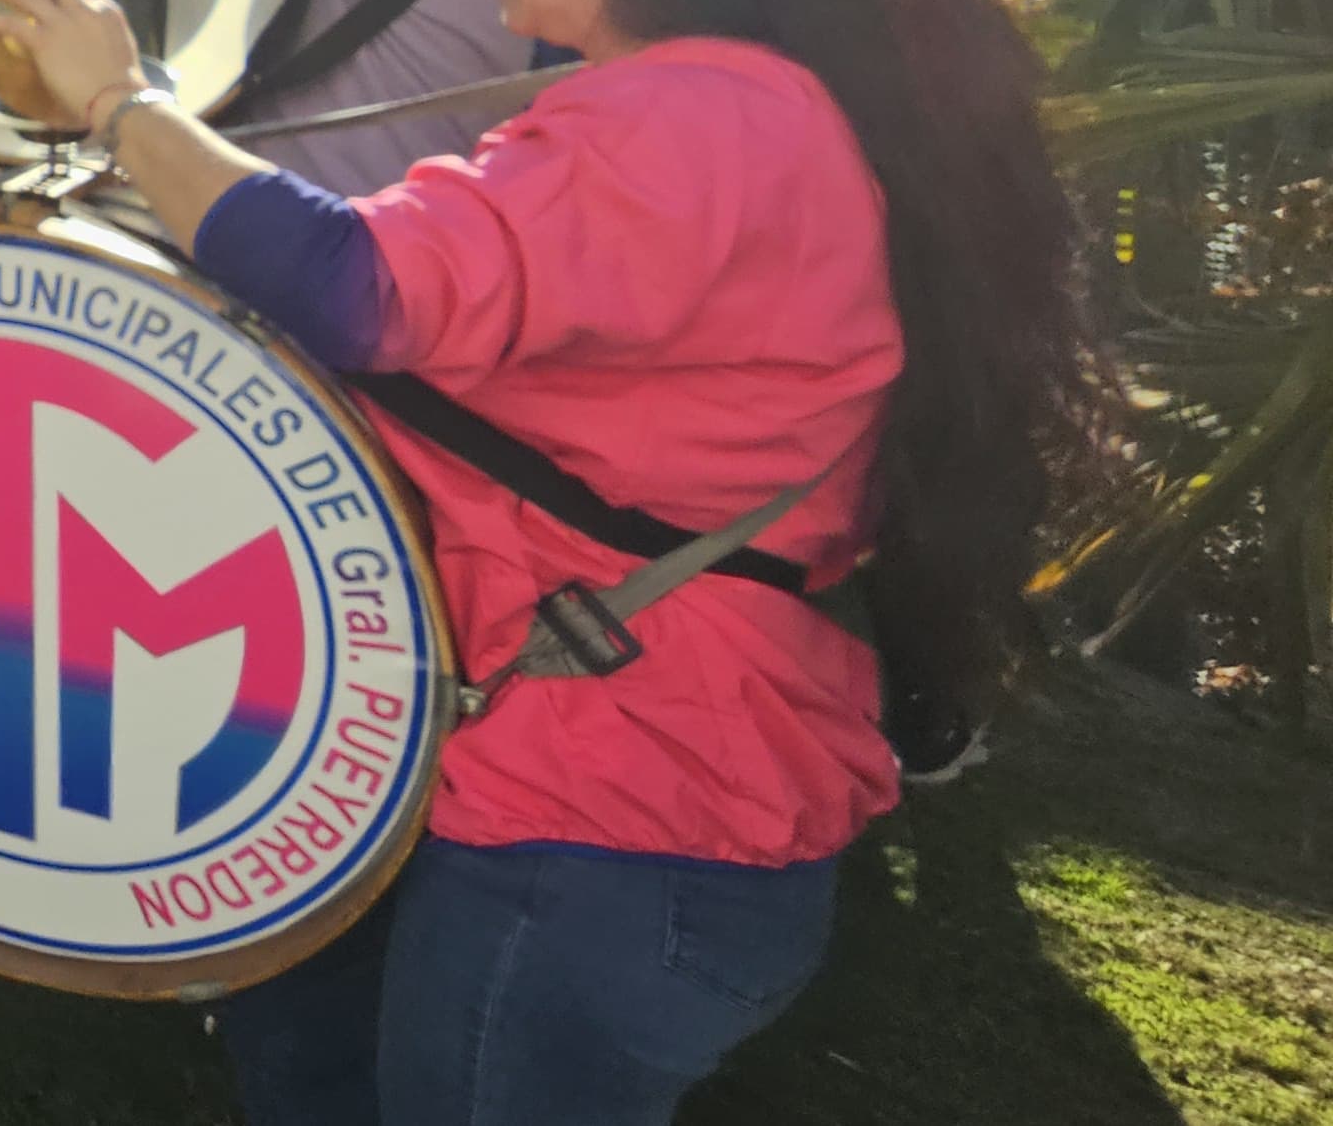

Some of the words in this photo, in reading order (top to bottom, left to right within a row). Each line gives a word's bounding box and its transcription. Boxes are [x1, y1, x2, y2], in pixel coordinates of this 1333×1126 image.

[283, 451, 369, 530] DE
[332, 545, 408, 664] Gral.
[128, 681, 406, 930] PUEYRREDON
